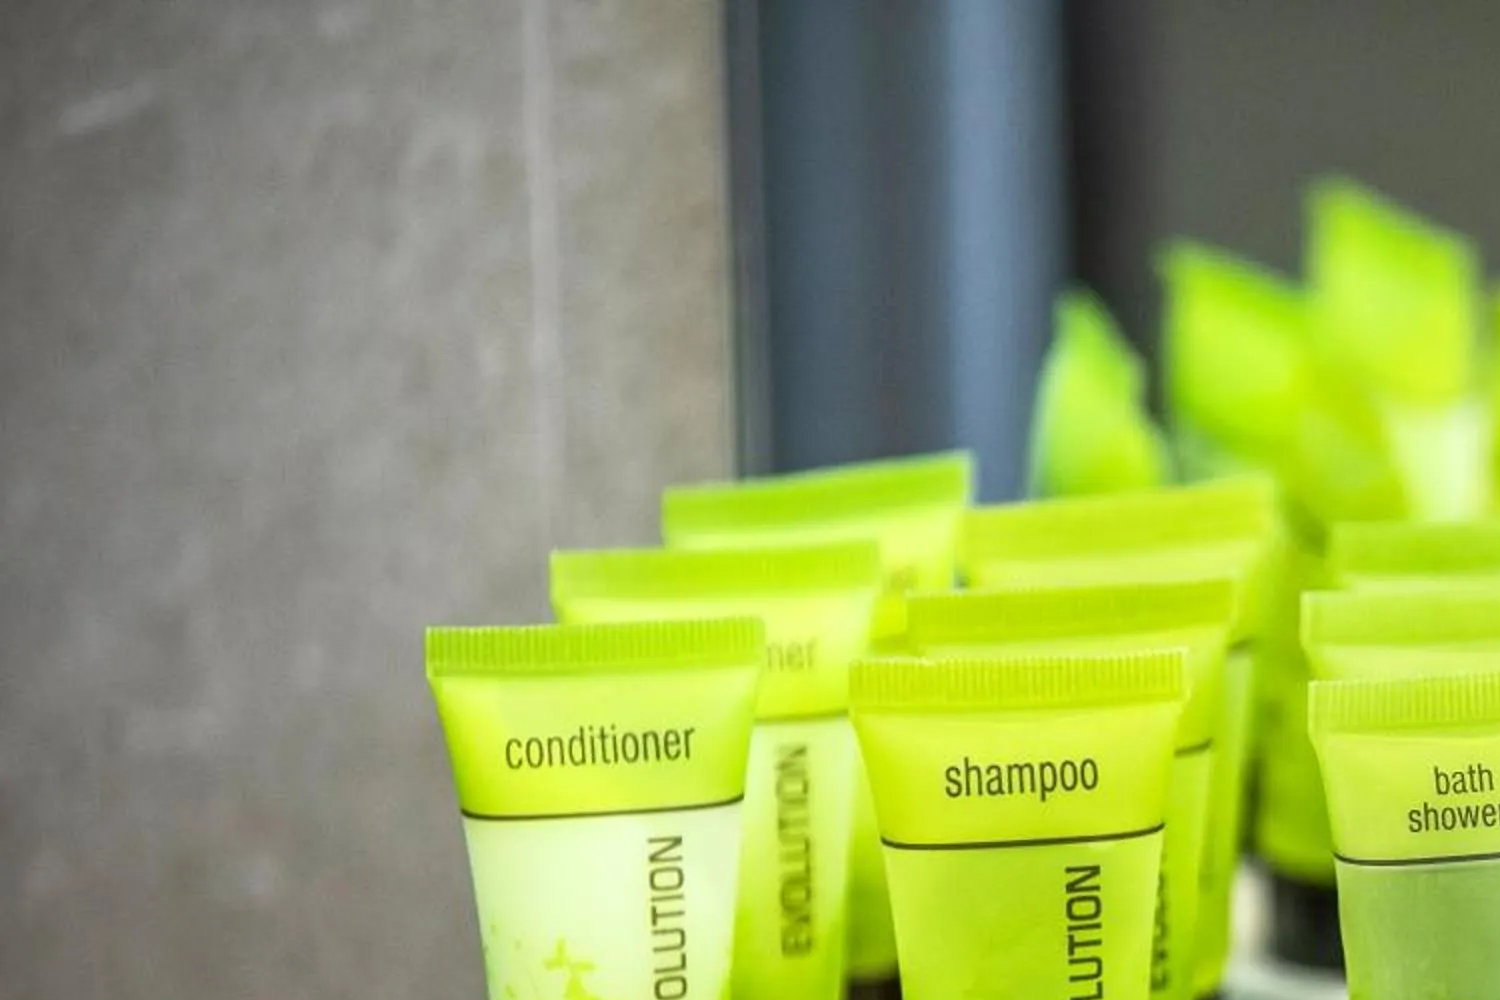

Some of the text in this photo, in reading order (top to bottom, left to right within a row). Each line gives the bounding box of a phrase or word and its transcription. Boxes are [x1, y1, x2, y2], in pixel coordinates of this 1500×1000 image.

[505, 724, 697, 769] conditioner
[944, 757, 1100, 801] shampoo
[1434, 765, 1494, 795] bath
